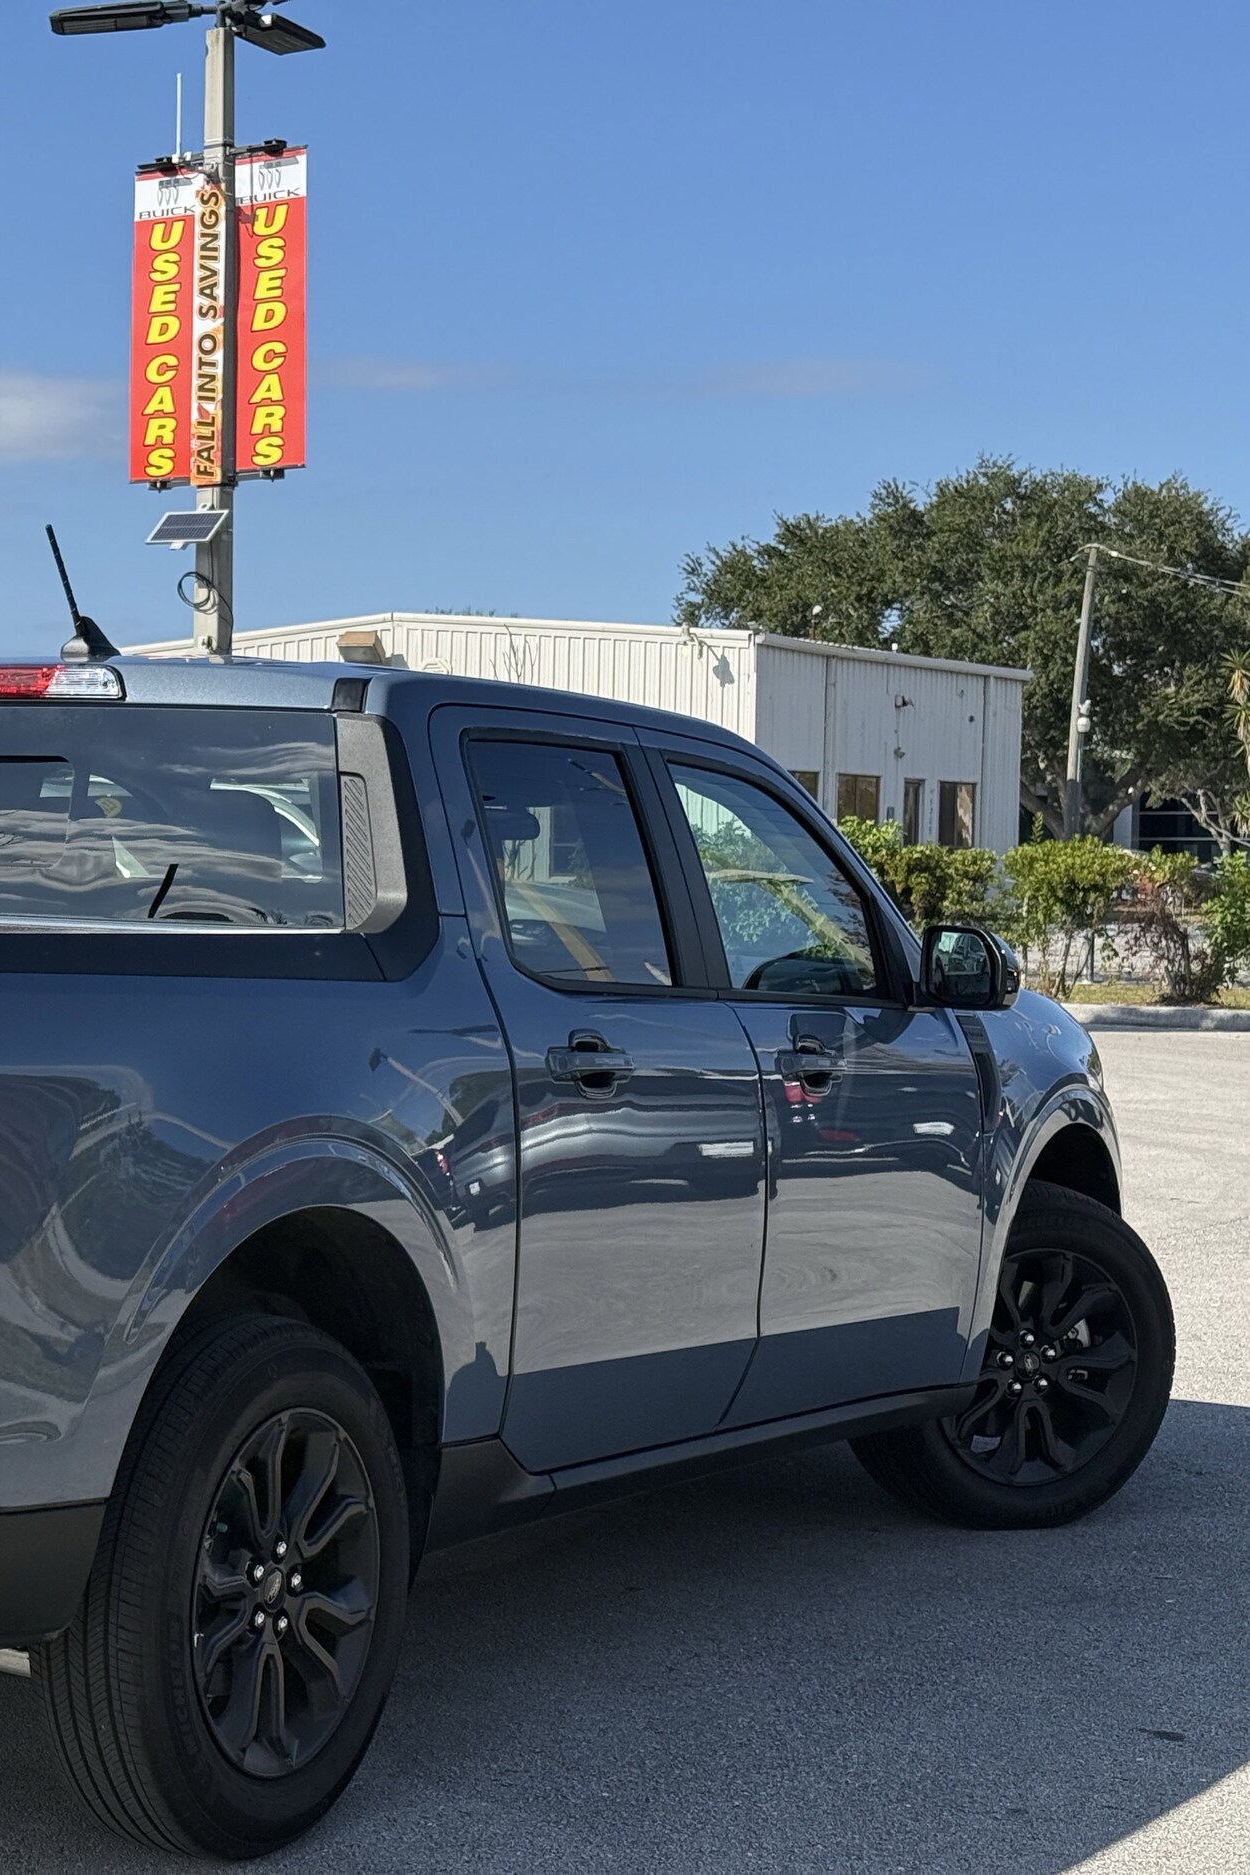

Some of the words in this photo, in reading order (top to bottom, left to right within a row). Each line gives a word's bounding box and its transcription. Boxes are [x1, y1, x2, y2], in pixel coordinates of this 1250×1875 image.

[138, 204, 196, 219] BUICK
[198, 190, 220, 320] SAVINGS
[239, 187, 300, 204] BUICK
[145, 219, 185, 345] USED
[251, 202, 289, 333] USED
[142, 353, 180, 477] CARS
[197, 333, 217, 403] INTO
[248, 340, 288, 466] CARS
[196, 415, 215, 478] FALL
